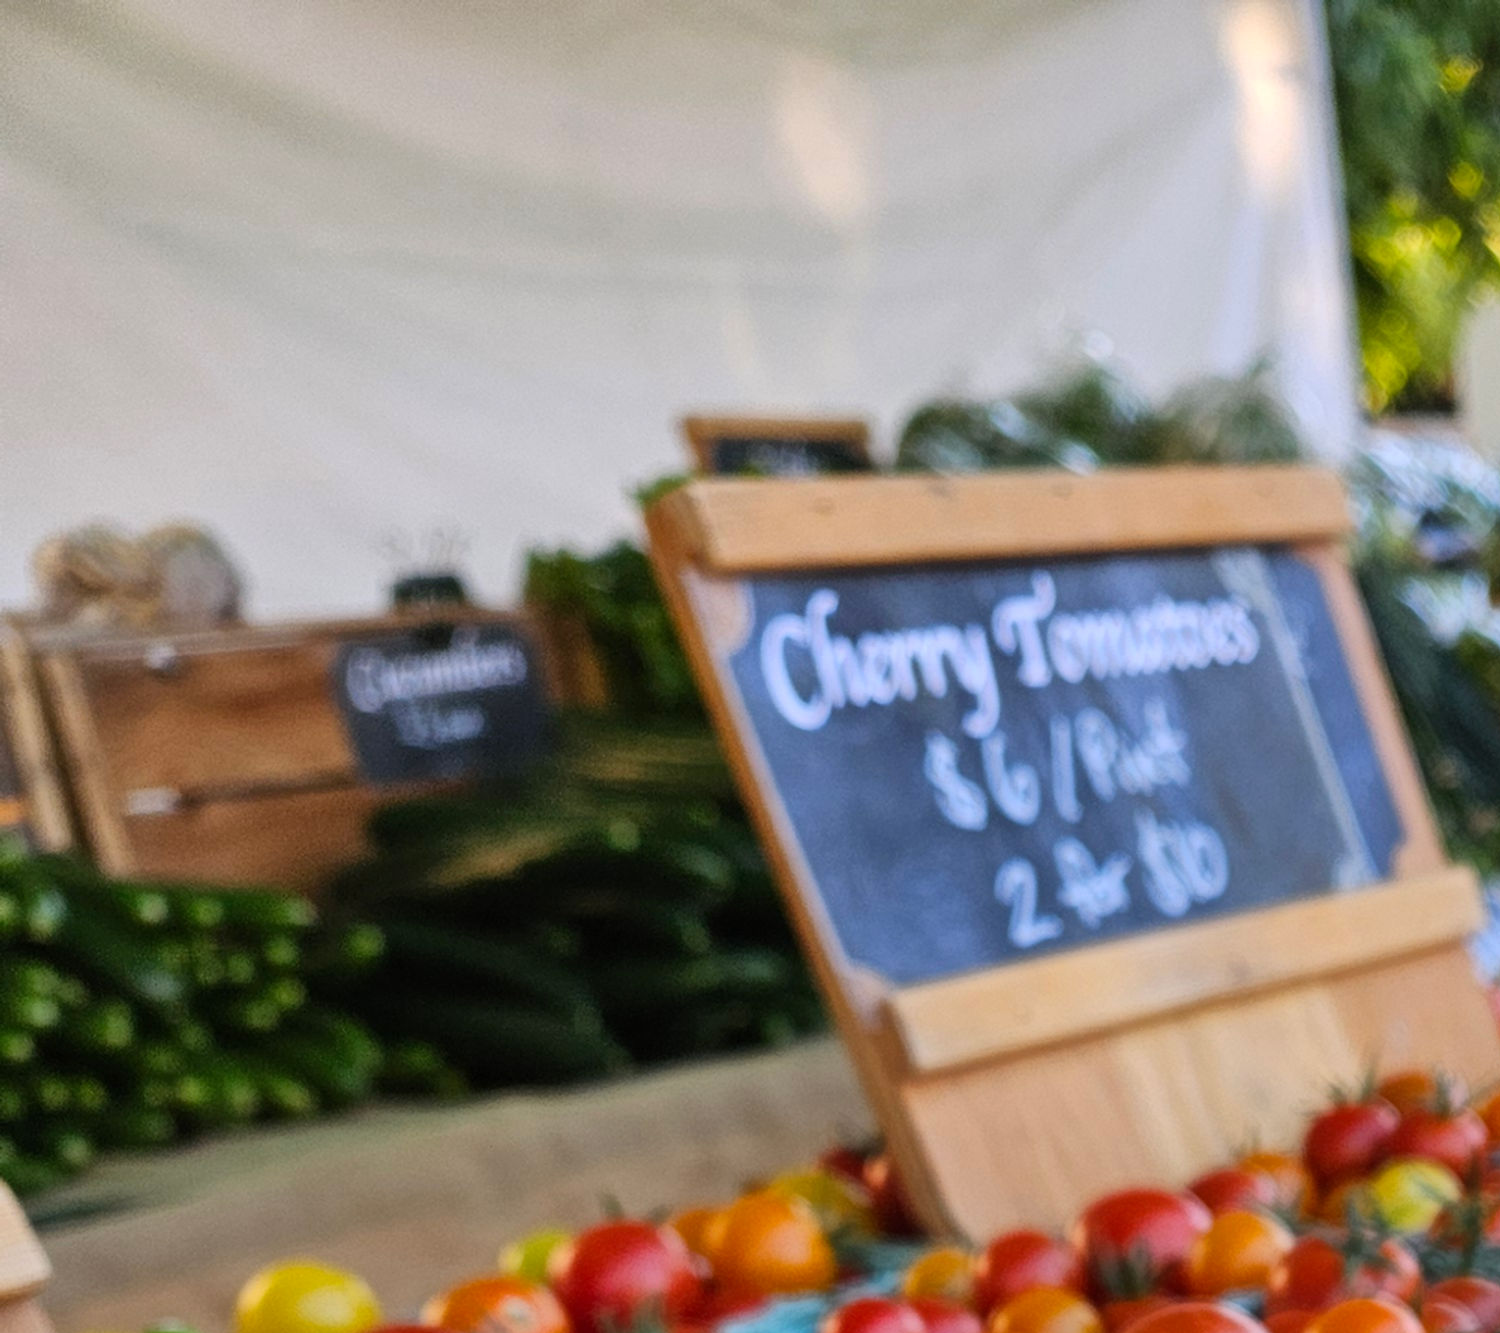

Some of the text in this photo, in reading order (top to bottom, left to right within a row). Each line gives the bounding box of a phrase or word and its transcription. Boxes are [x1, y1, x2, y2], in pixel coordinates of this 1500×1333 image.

[760, 570, 1260, 740] Cherry Tomatoes
[994, 856, 1064, 949] 2
